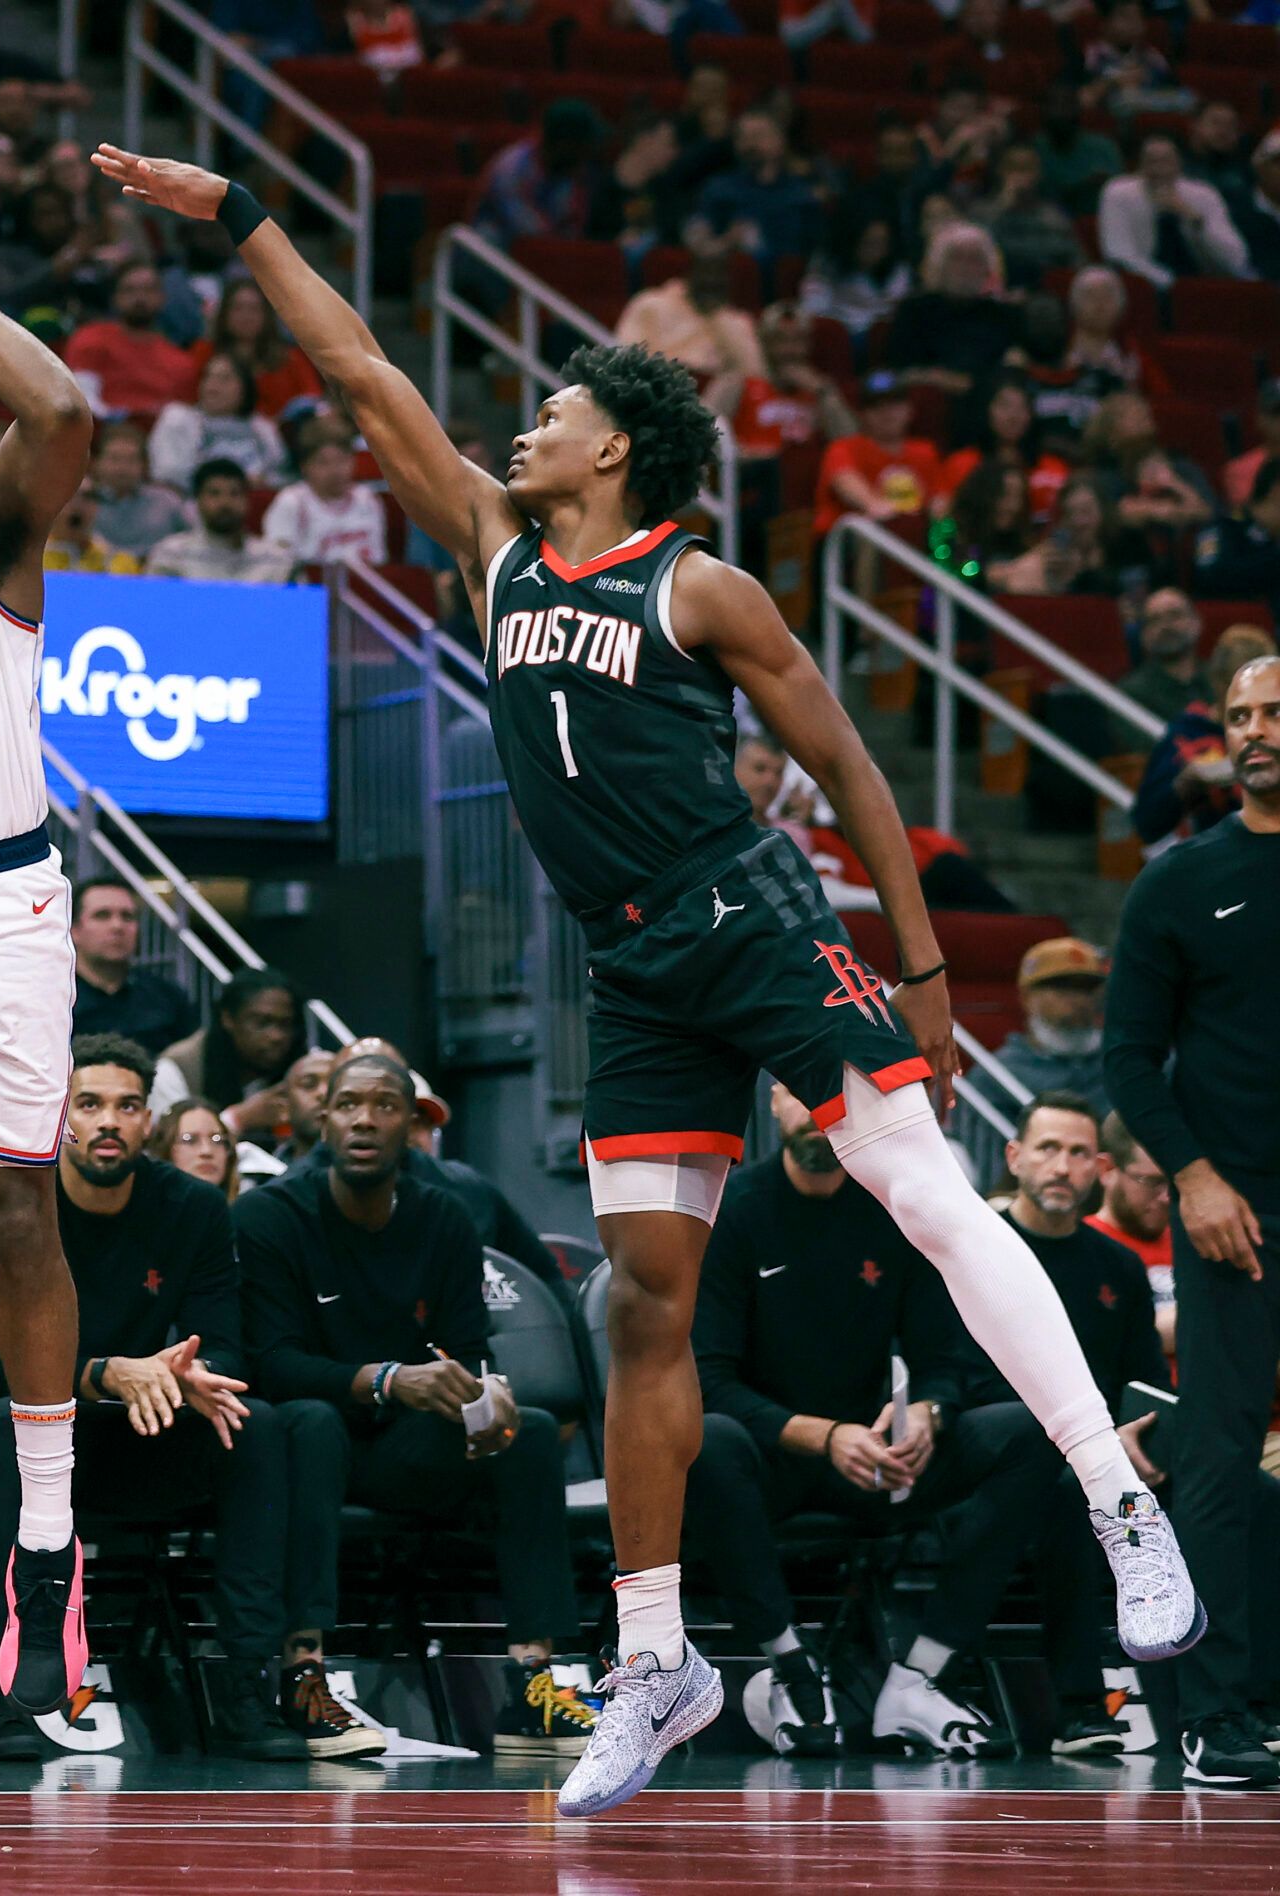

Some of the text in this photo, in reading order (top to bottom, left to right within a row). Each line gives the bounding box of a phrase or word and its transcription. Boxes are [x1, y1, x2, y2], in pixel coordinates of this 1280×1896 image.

[496, 605, 643, 688] HOUSTON
[41, 626, 262, 762] Kroger
[549, 689, 580, 779] 1
